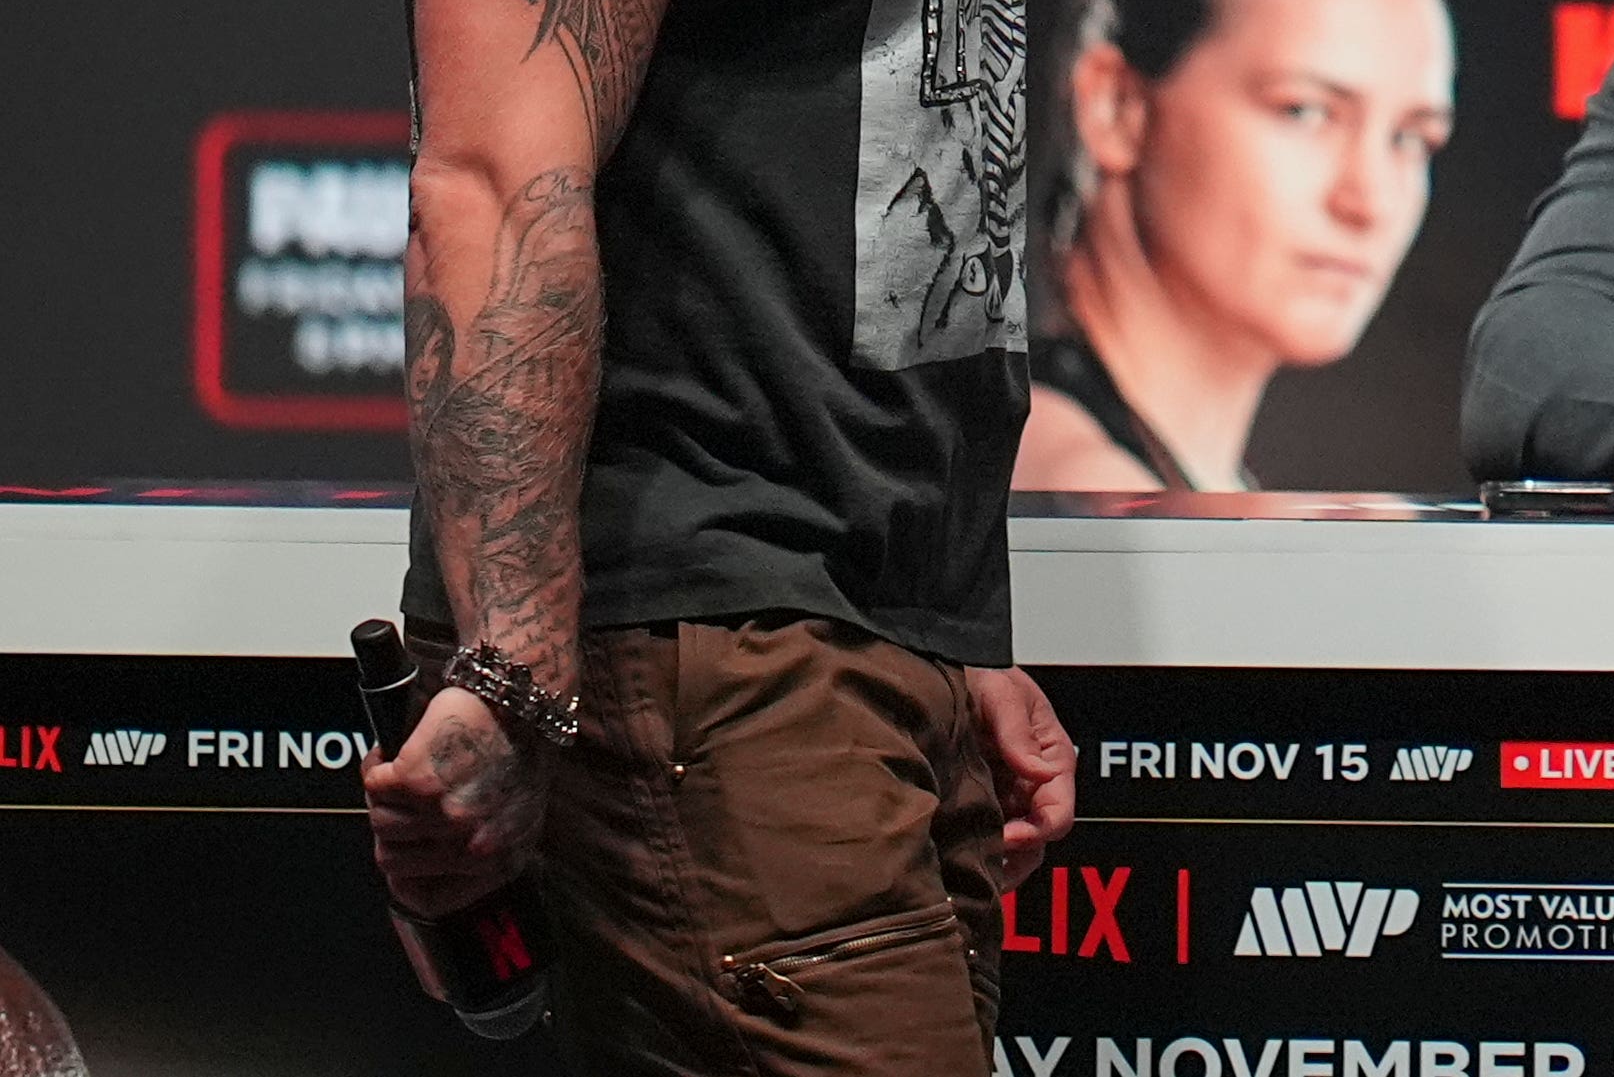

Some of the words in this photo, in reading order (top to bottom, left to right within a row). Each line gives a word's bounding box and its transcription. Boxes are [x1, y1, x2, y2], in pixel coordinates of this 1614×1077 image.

[188, 730, 263, 768] FRI
[1100, 741, 1176, 779] FRI
[1191, 742, 1300, 781] NOV
[1315, 743, 1369, 782] 15
[1442, 894, 1533, 920] MOST
[1095, 1036, 1586, 1077] NOVEMBER
